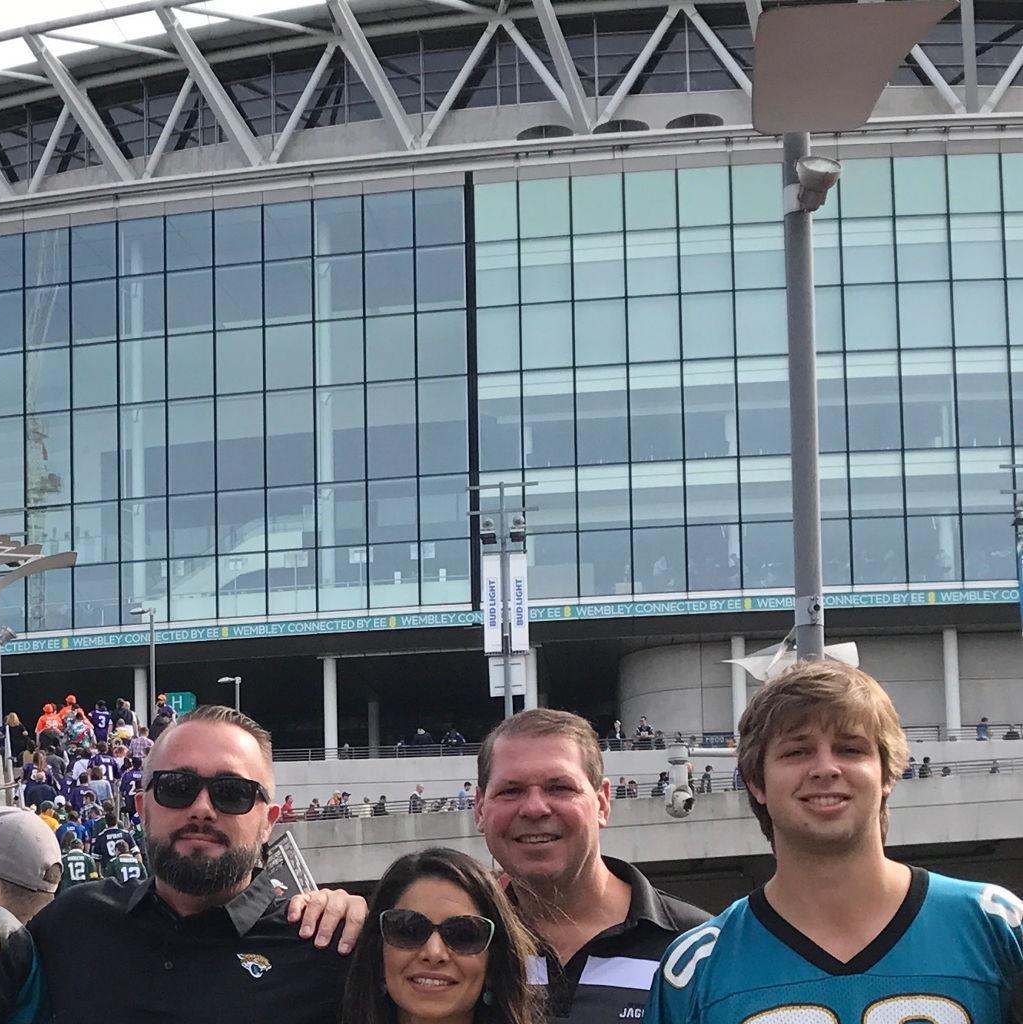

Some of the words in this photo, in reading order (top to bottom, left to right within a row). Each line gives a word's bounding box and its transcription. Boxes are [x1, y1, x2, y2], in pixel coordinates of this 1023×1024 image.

[488, 580, 496, 606] LIGHT
[515, 579, 523, 605] LIGHT
[756, 596, 796, 609] WEMB
[892, 592, 909, 604] BY
[911, 592, 925, 603] EE
[940, 589, 999, 602] WEMBLEY
[401, 612, 456, 626] WEMBLEY
[530, 608, 546, 619] BY
[547, 607, 561, 618] EE
[576, 604, 633, 617] WEMBLEY
[635, 600, 707, 614] CONNECTED
[710, 600, 726, 611] BY
[728, 599, 742, 610] EE
[233, 623, 286, 637] WEMBLEY
[287, 619, 355, 634] CONNECTED
[356, 618, 372, 630] BY
[373, 617, 387, 628] EE
[32, 639, 47, 651] BY
[48, 638, 61, 650] EE
[72, 633, 124, 647] WEMBLEY
[190, 628, 206, 639] BY
[207, 626, 220, 638] EE
[172, 695, 182, 709] H
[67, 861, 86, 881] 12
[619, 1007, 645, 1018] JAG
